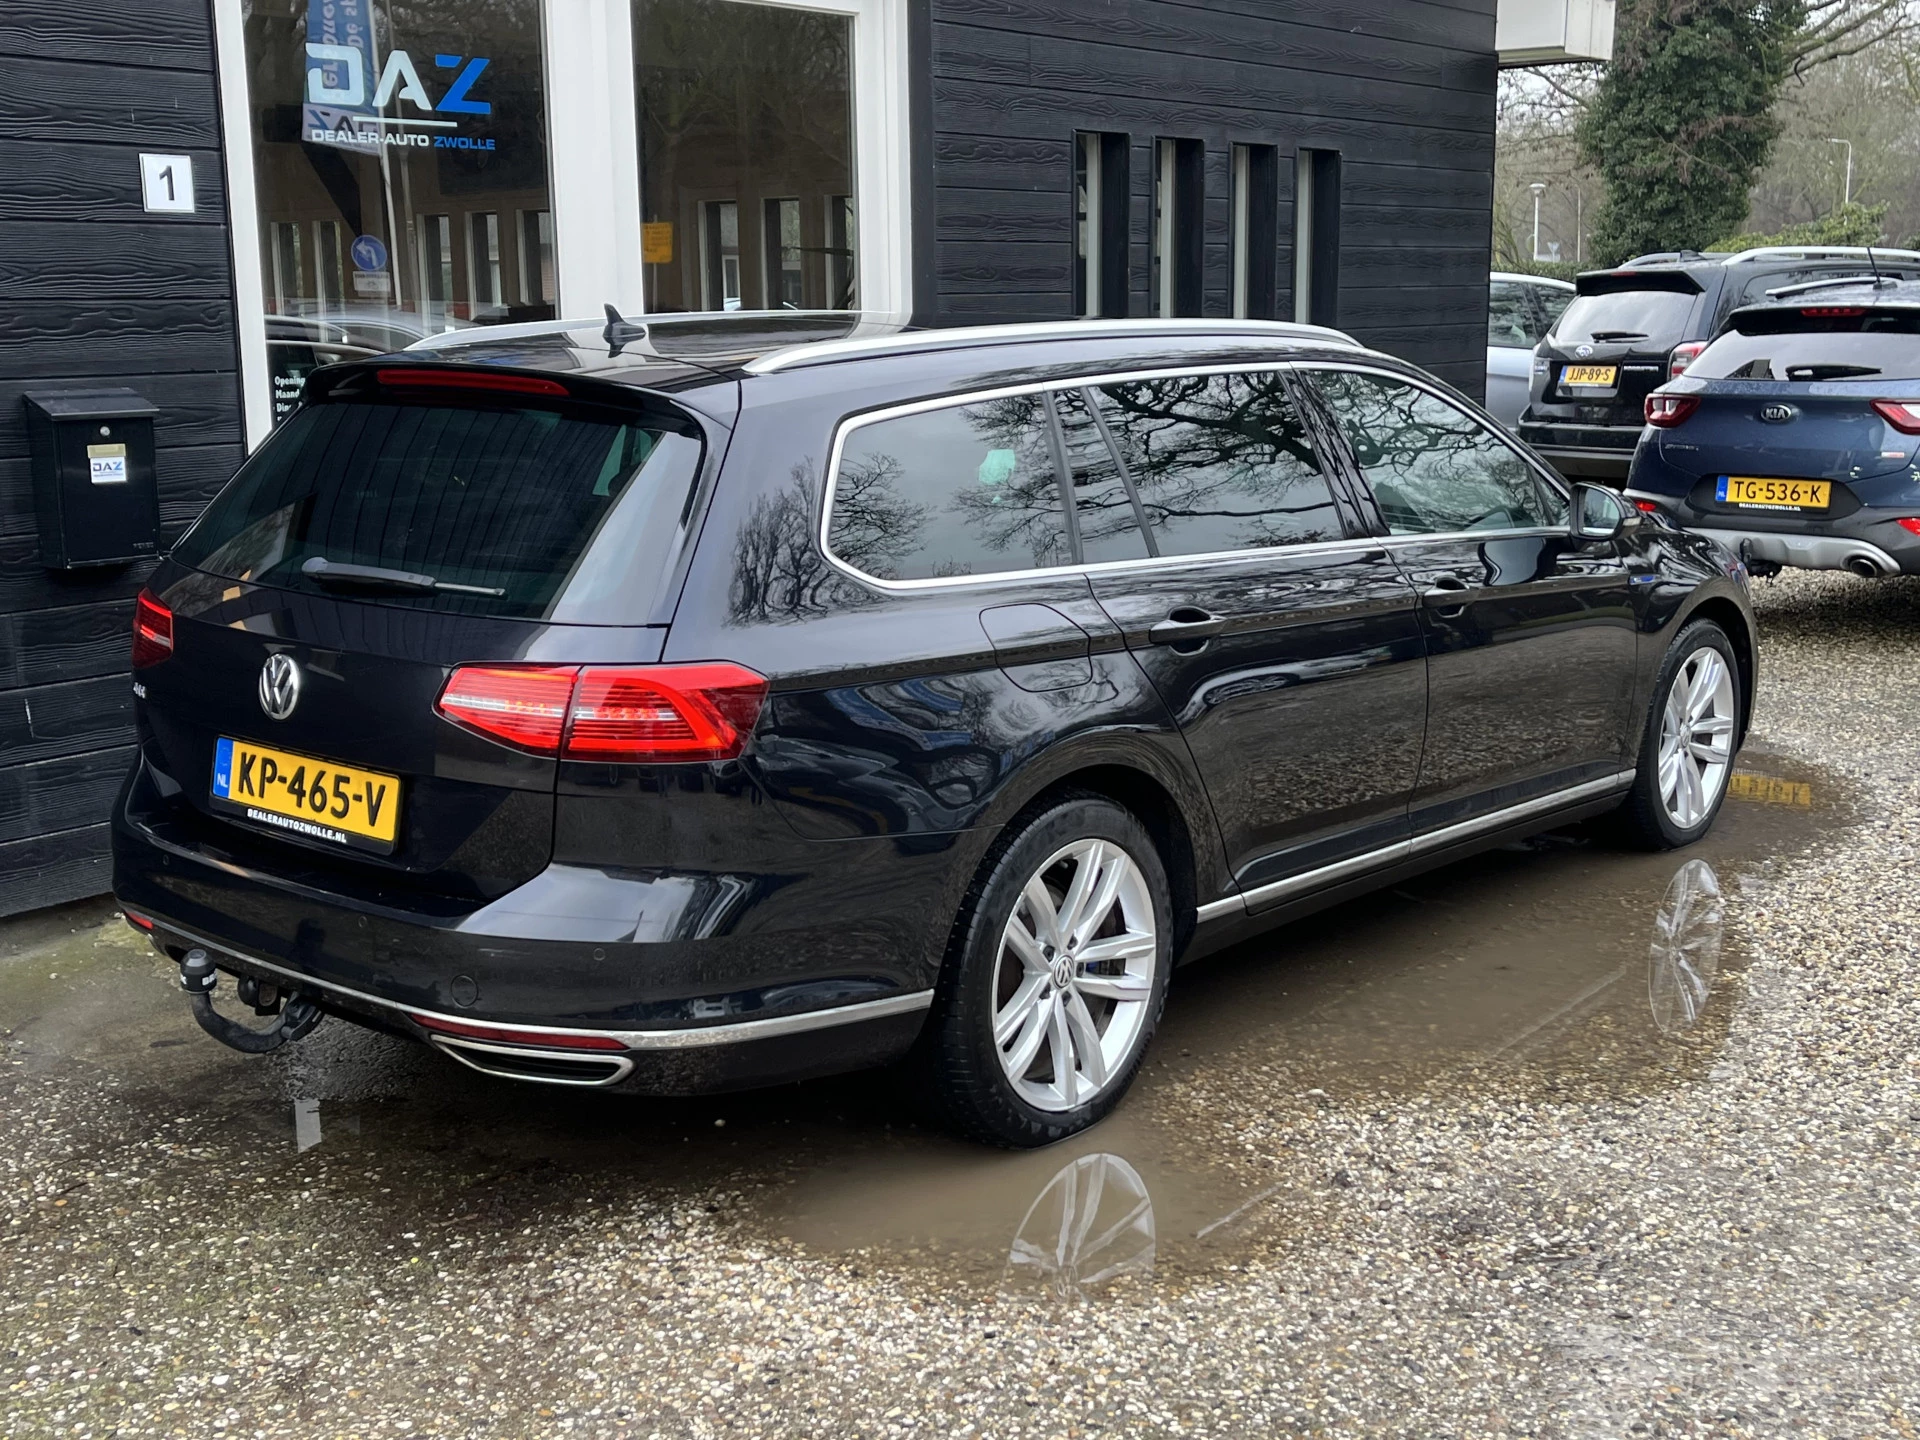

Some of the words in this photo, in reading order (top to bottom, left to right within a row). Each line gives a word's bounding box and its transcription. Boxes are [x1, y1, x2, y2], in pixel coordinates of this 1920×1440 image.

[305, 42, 491, 115] DAZ
[311, 129, 429, 147] DEALER-AUTO
[433, 136, 496, 150] ZWOLLE
[159, 165, 175, 201] 1
[1765, 408, 1786, 419] KIA
[92, 460, 123, 472] DAZ
[1734, 481, 1821, 503] TG-536-K
[216, 773, 229, 789] NL
[238, 751, 386, 828] KP-465-V
[247, 808, 347, 844] DEALERAUTOZWOLLE.NL
